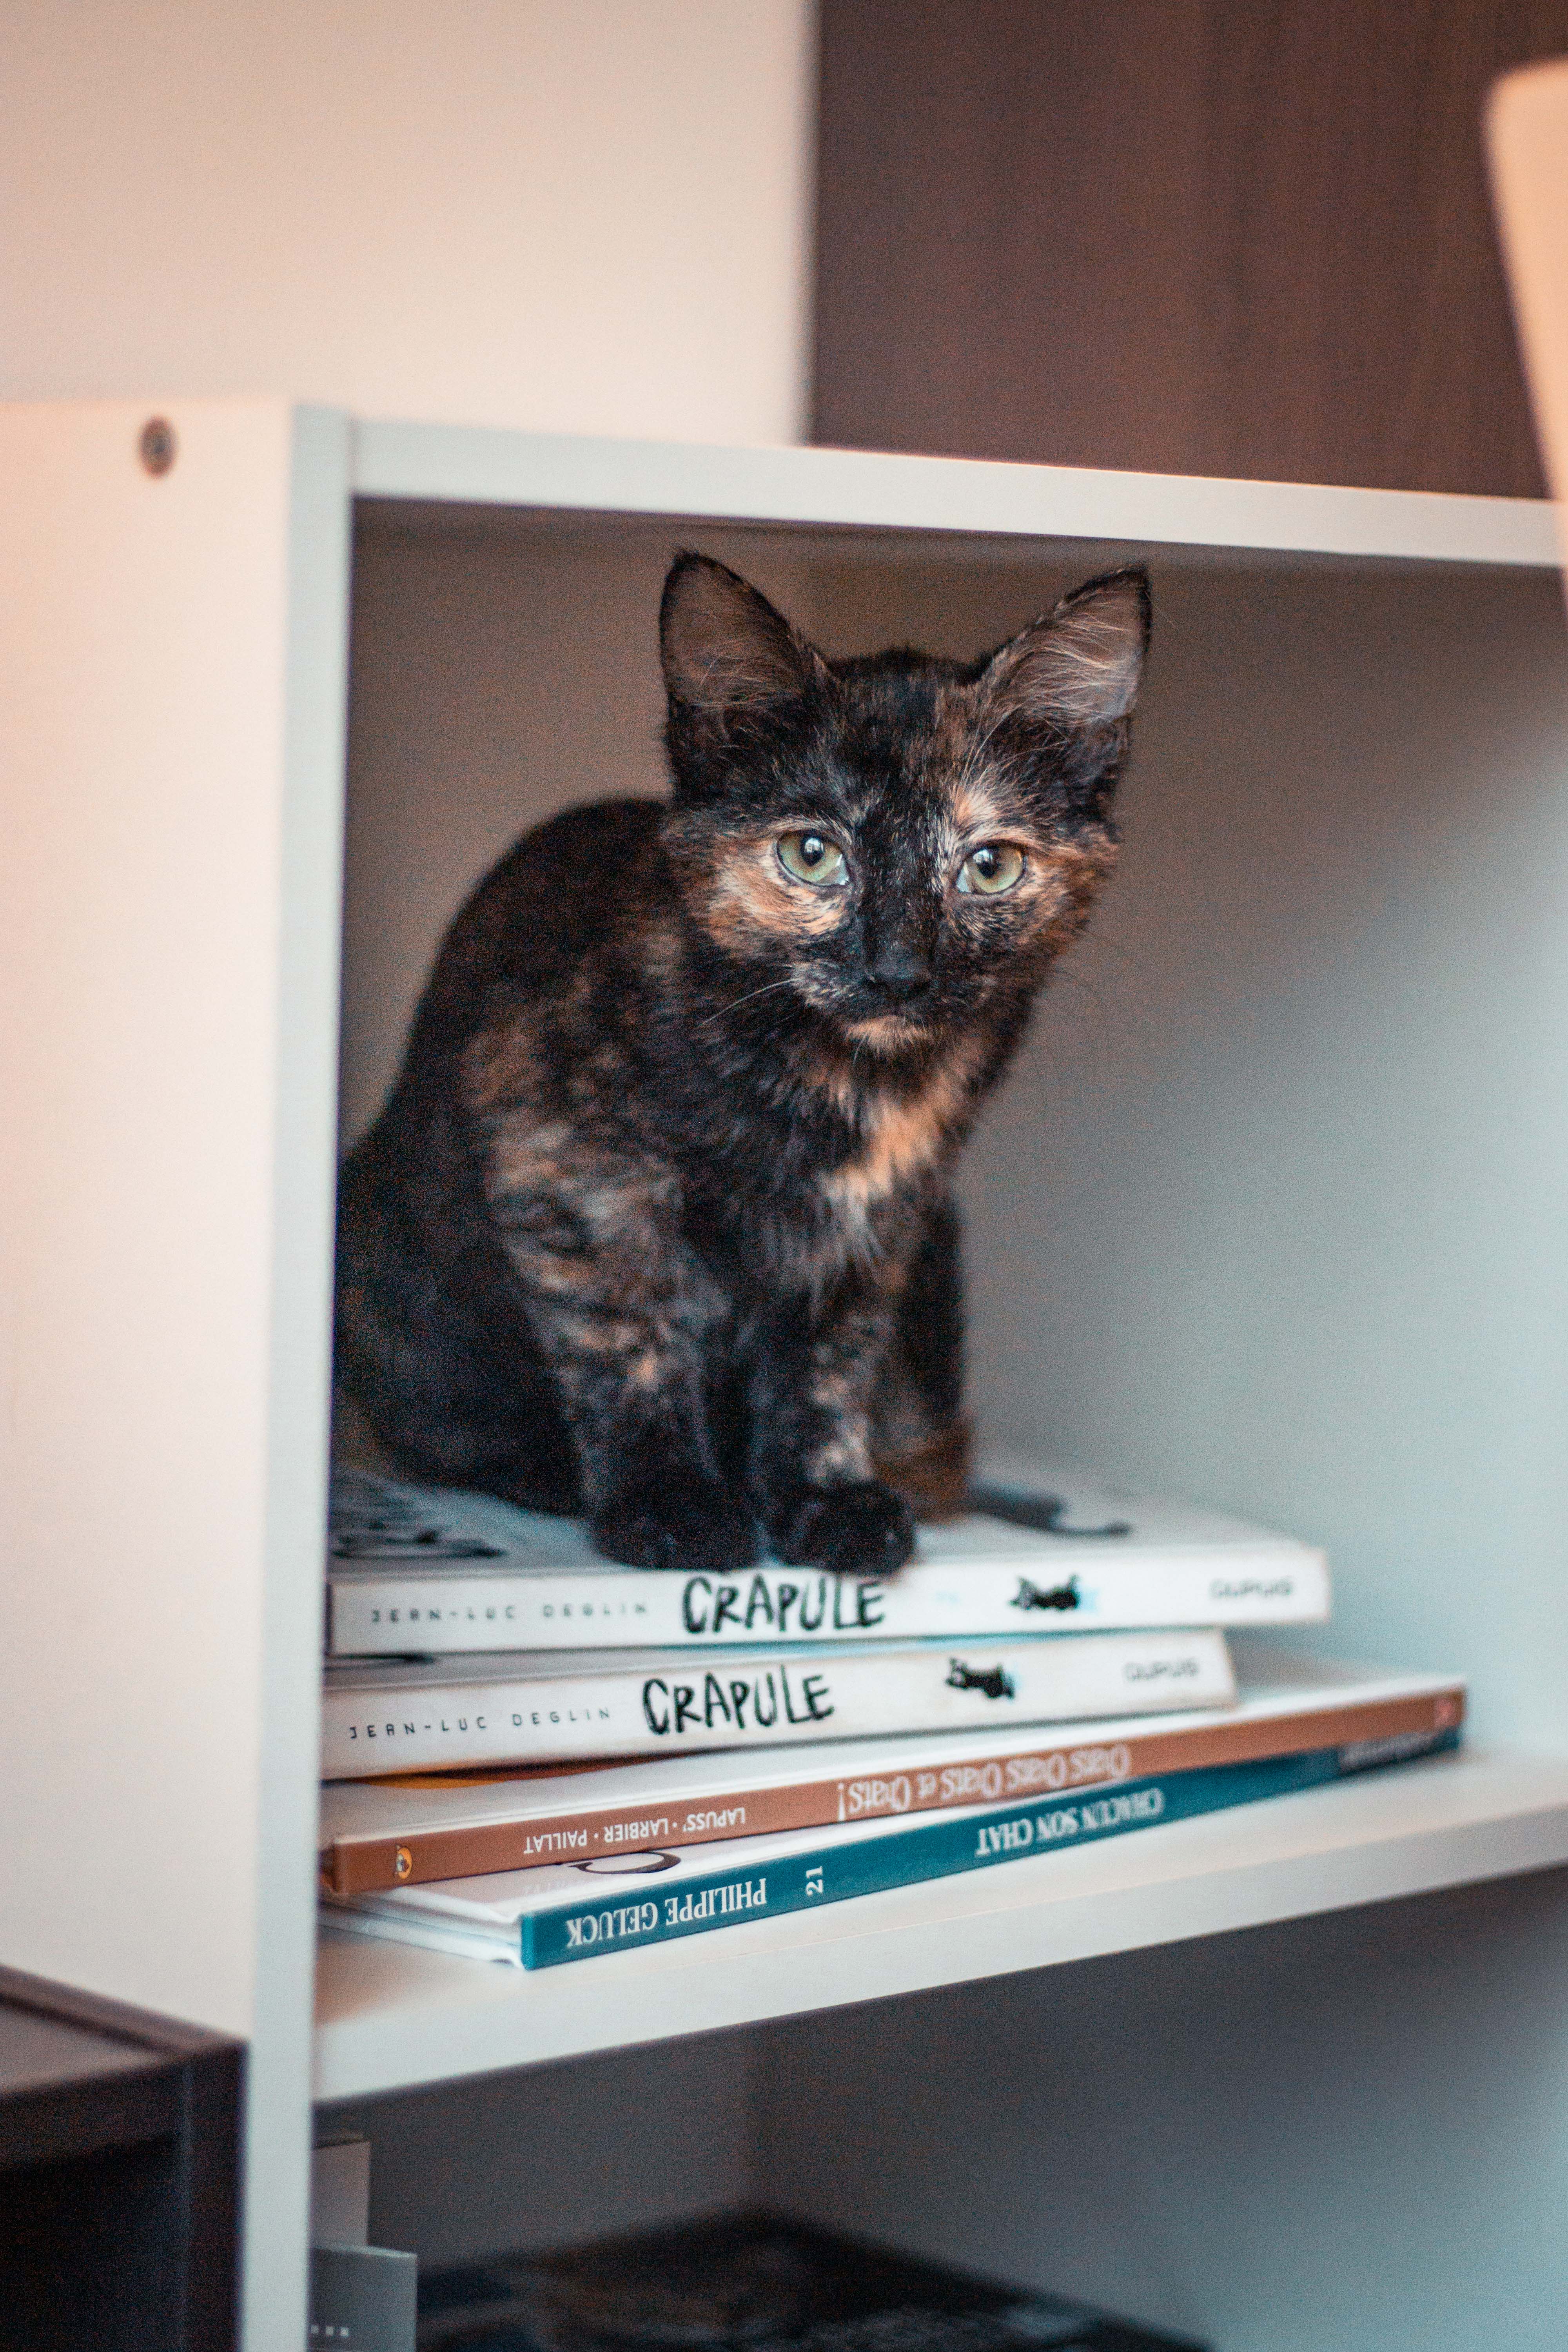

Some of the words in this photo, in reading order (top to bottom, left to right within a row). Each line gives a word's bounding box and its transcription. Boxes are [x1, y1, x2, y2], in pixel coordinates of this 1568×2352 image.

[682, 1573, 887, 1634] CRAPULE
[642, 1664, 835, 1736] CRAPULE
[349, 1715, 488, 1740] JEAN-LUC
[511, 1708, 610, 1728] DEGLIN
[523, 1829, 587, 1854] PAILLAT
[603, 1817, 669, 1843] LARBIER
[975, 1818, 1034, 1857] CHAT
[1035, 1806, 1080, 1842] SON
[806, 1866, 824, 1896] 21
[665, 1878, 767, 1926] PHILIPPE
[566, 1902, 659, 1947] GELUCK
